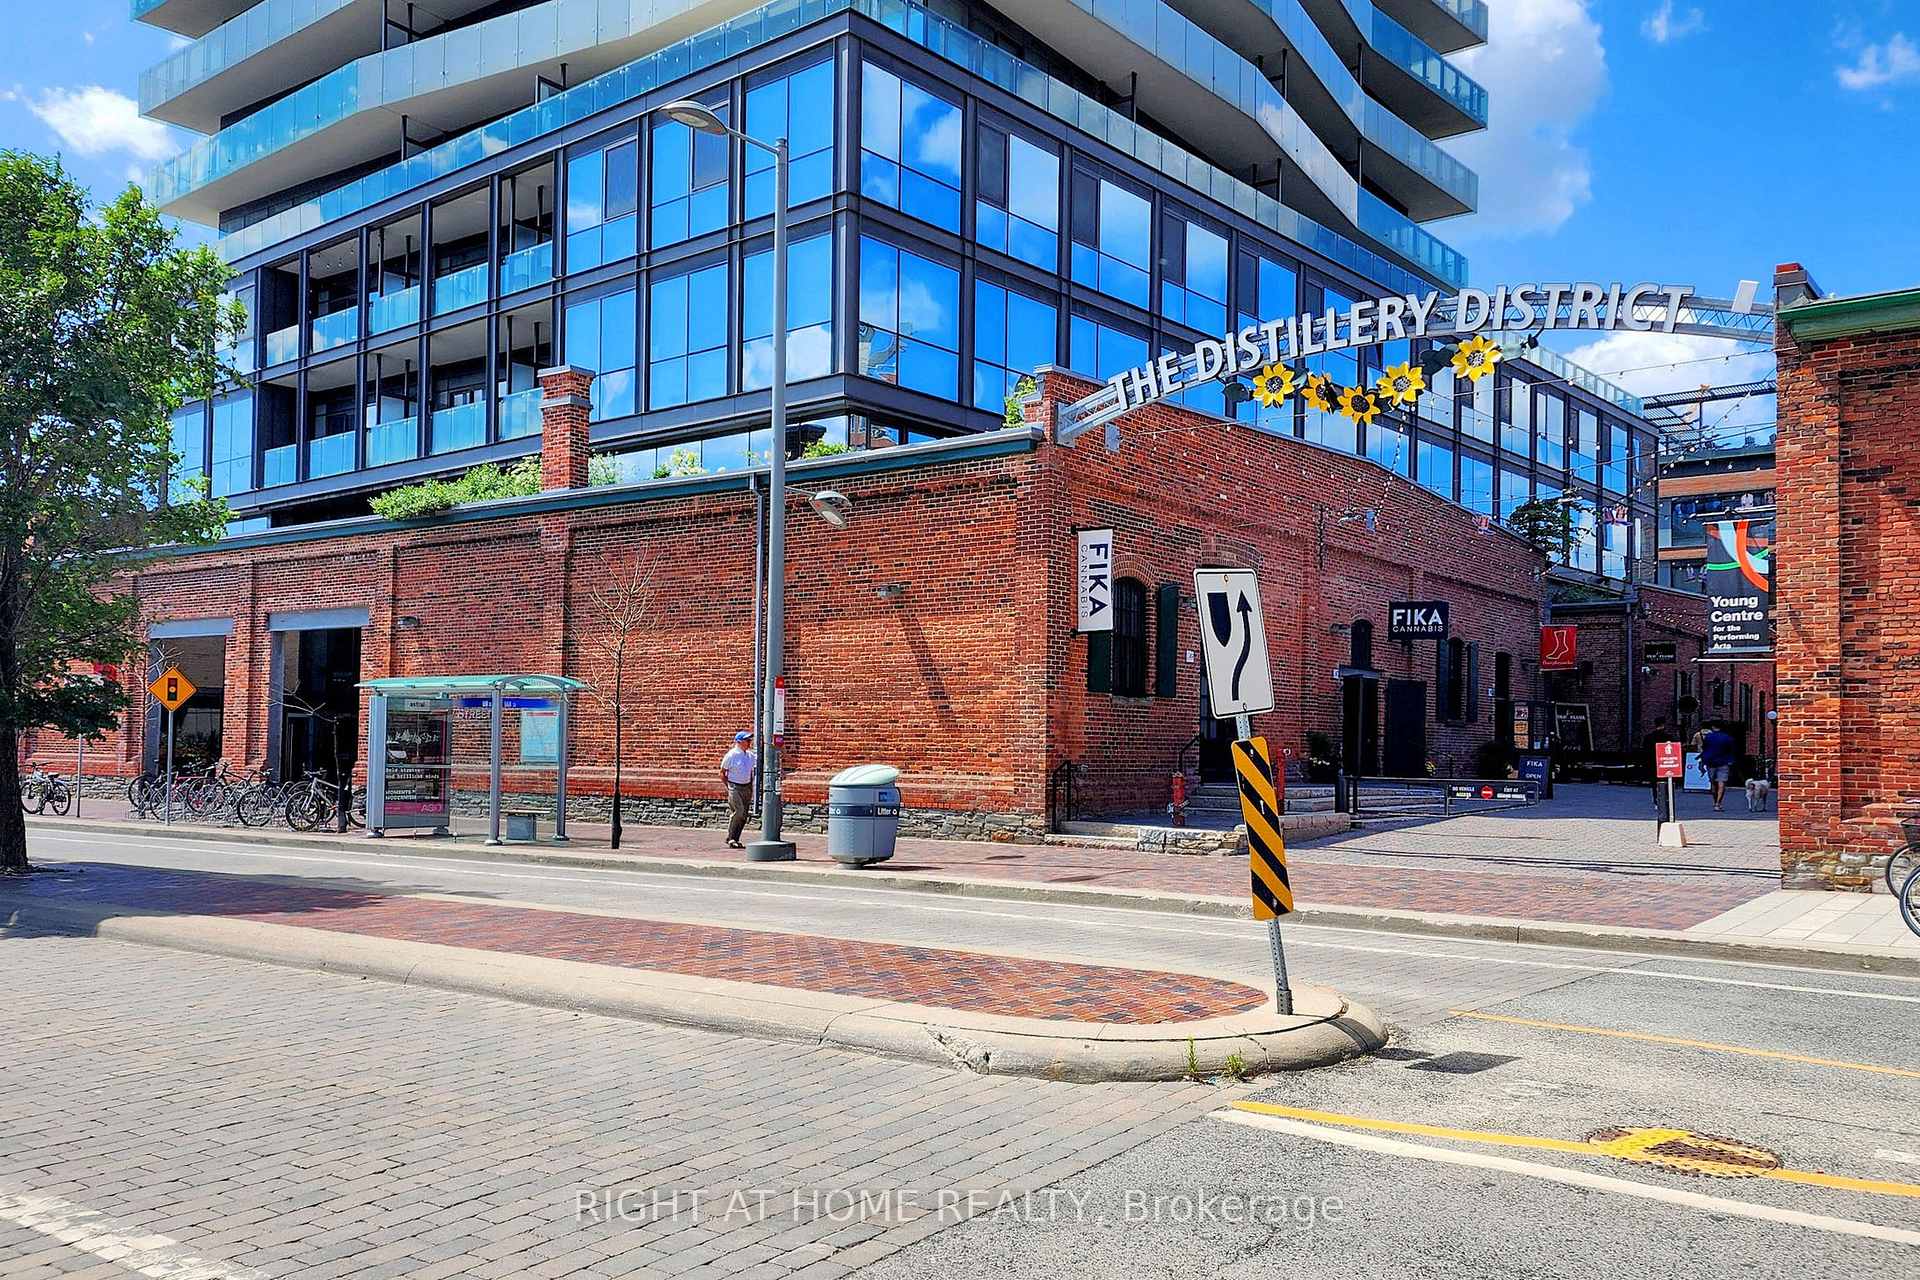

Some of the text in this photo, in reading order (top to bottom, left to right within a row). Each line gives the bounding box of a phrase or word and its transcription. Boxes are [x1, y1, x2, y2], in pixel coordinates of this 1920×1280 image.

[1108, 282, 1696, 411] THE DISTILLERY DISTRICT
[1089, 543, 1108, 617] FIKA
[1711, 596, 1759, 608] Young
[1393, 609, 1443, 625] FIKA
[1711, 610, 1764, 622] Centre
[1713, 633, 1760, 641] Performing
[877, 807, 891, 816] Litter
